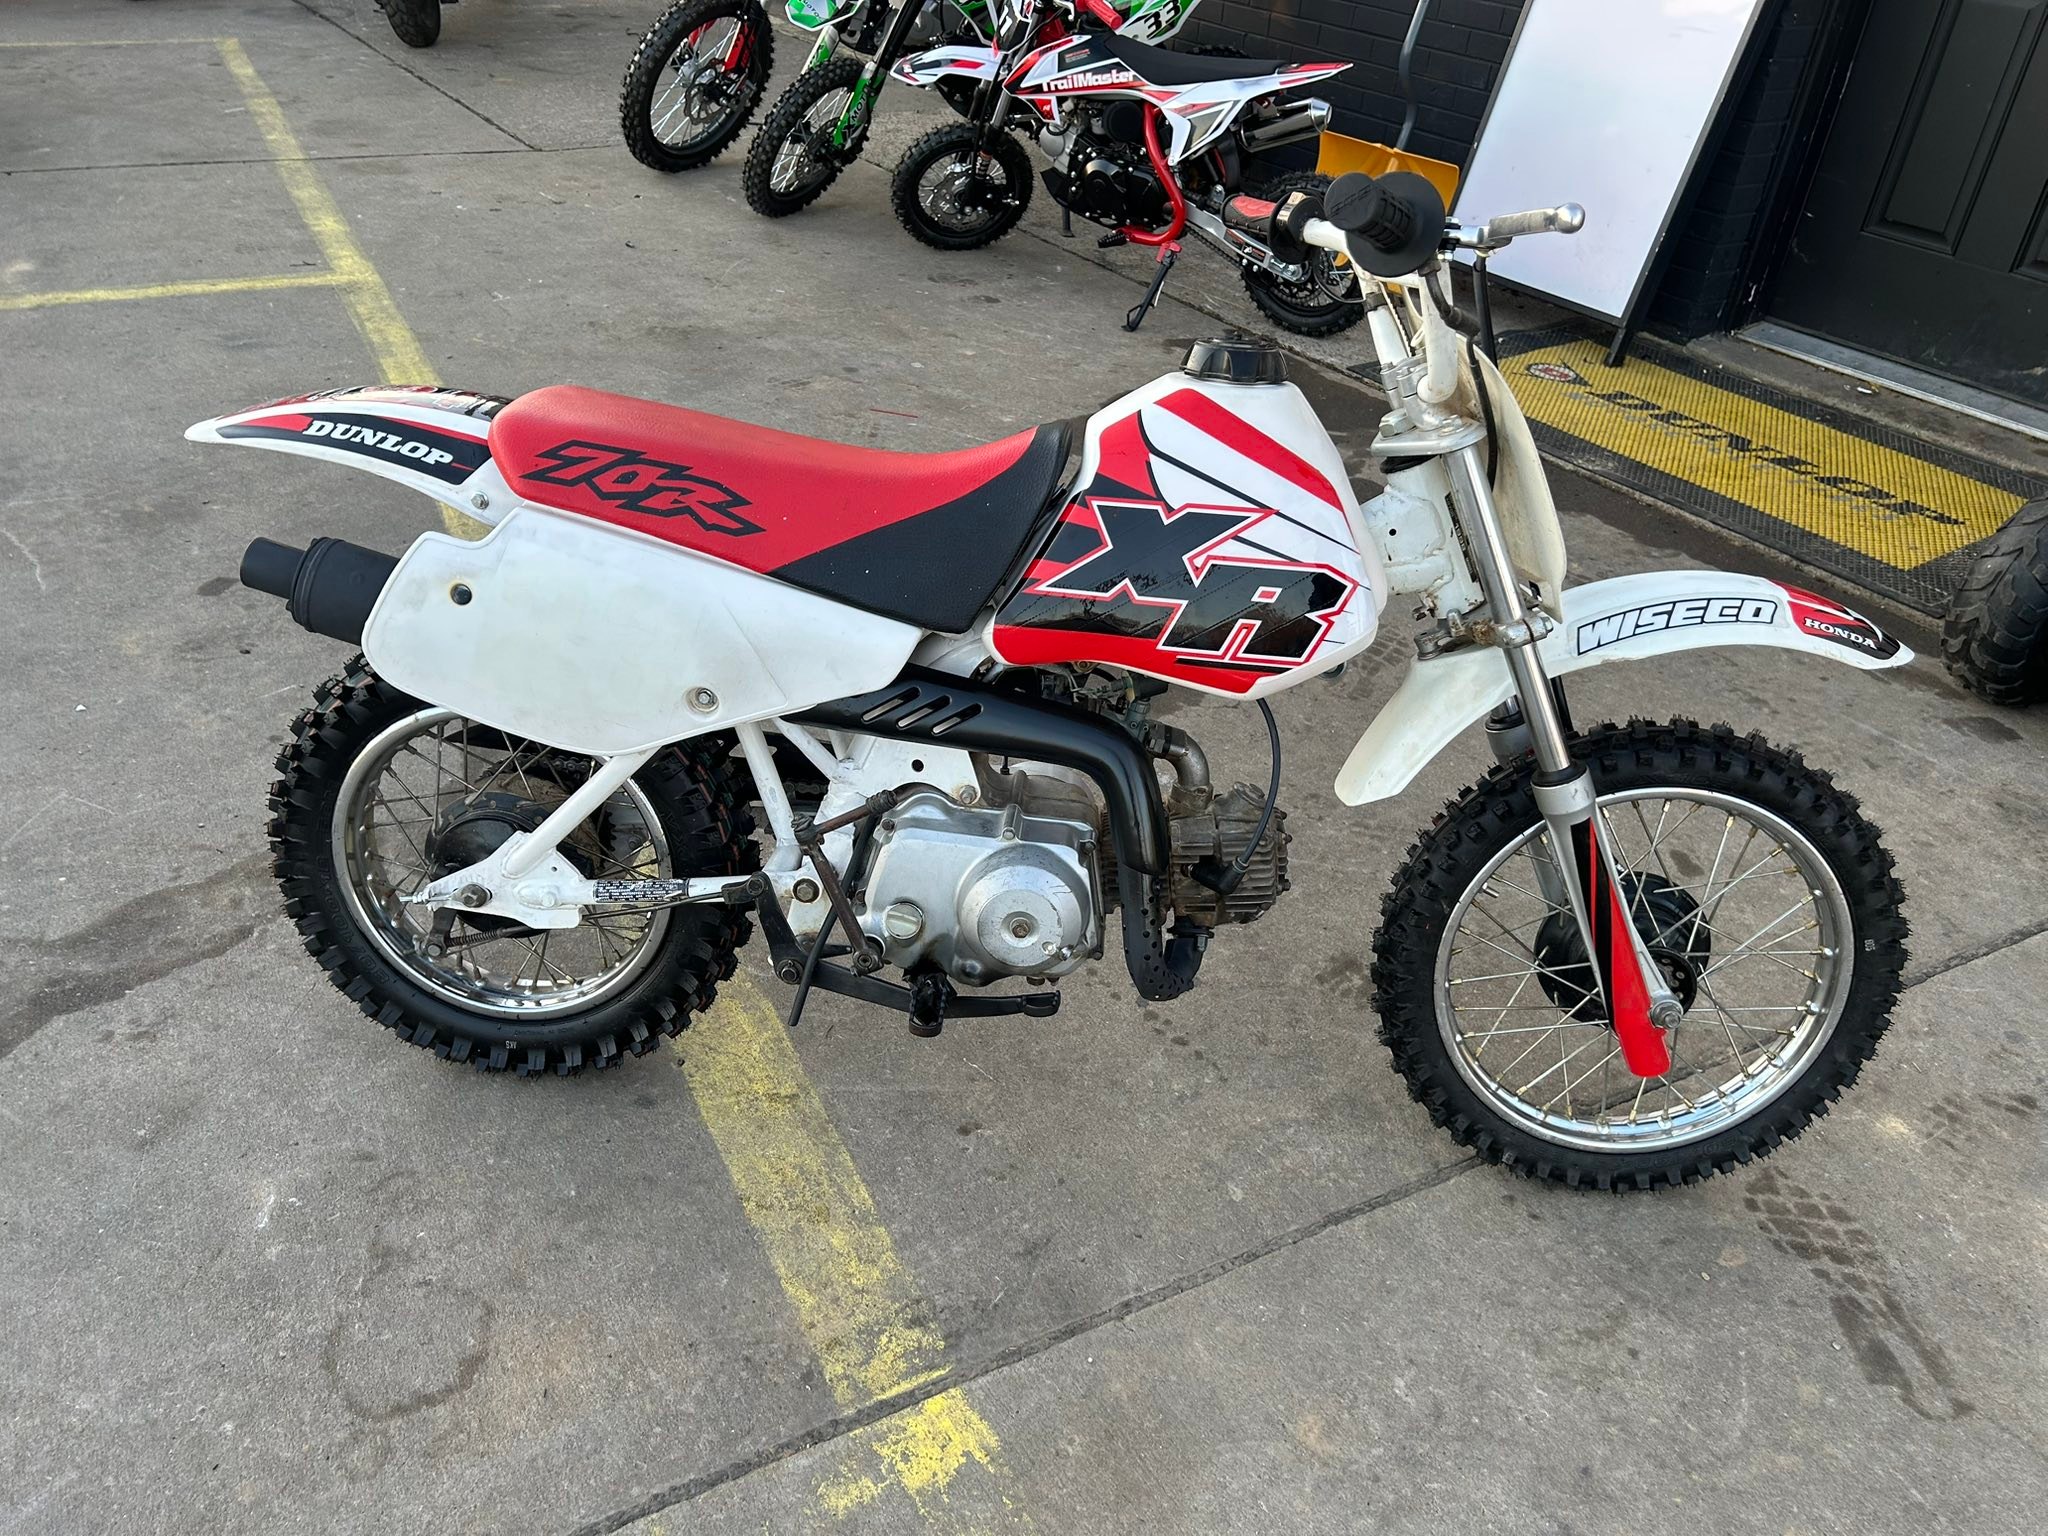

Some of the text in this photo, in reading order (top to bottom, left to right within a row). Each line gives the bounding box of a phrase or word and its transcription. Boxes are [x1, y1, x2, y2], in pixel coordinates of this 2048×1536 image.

[1042, 69, 1136, 92] TrailMaster
[302, 419, 455, 466] DUNLOP
[1585, 390, 1971, 525] DUNLOP
[1022, 496, 1360, 667] XR
[1577, 597, 1778, 656] WISECO
[1804, 617, 1878, 650] HONDA
